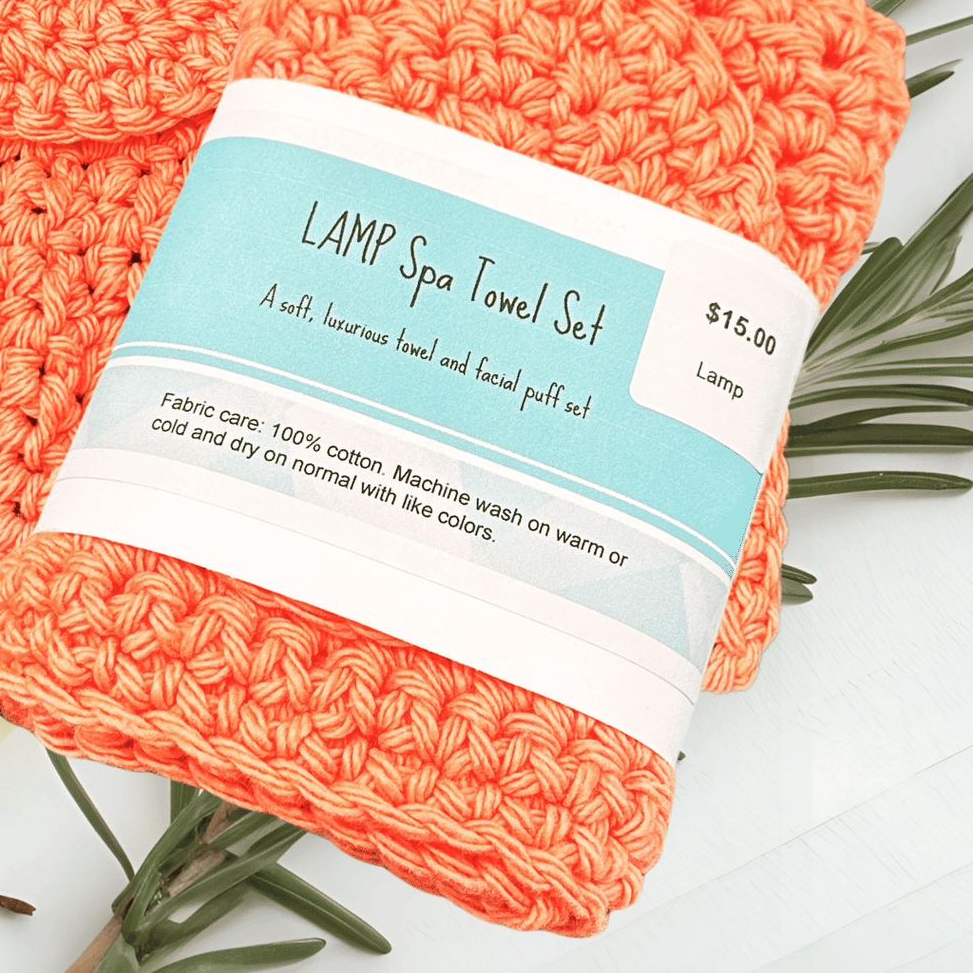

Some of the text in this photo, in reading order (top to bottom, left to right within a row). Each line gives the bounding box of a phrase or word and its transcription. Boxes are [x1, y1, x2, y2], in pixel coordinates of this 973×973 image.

[301, 200, 606, 346] LAMP Spa Towel Set
[705, 302, 776, 356] $15.00
[259, 283, 592, 420] A soft, luxurious towel and facial puff set
[696, 361, 744, 400] Lamp
[151, 418, 497, 543] cold and dry on normal with like colors.
[160, 392, 629, 567] Fabric care: 100% cotton. Machine wash on warm or
